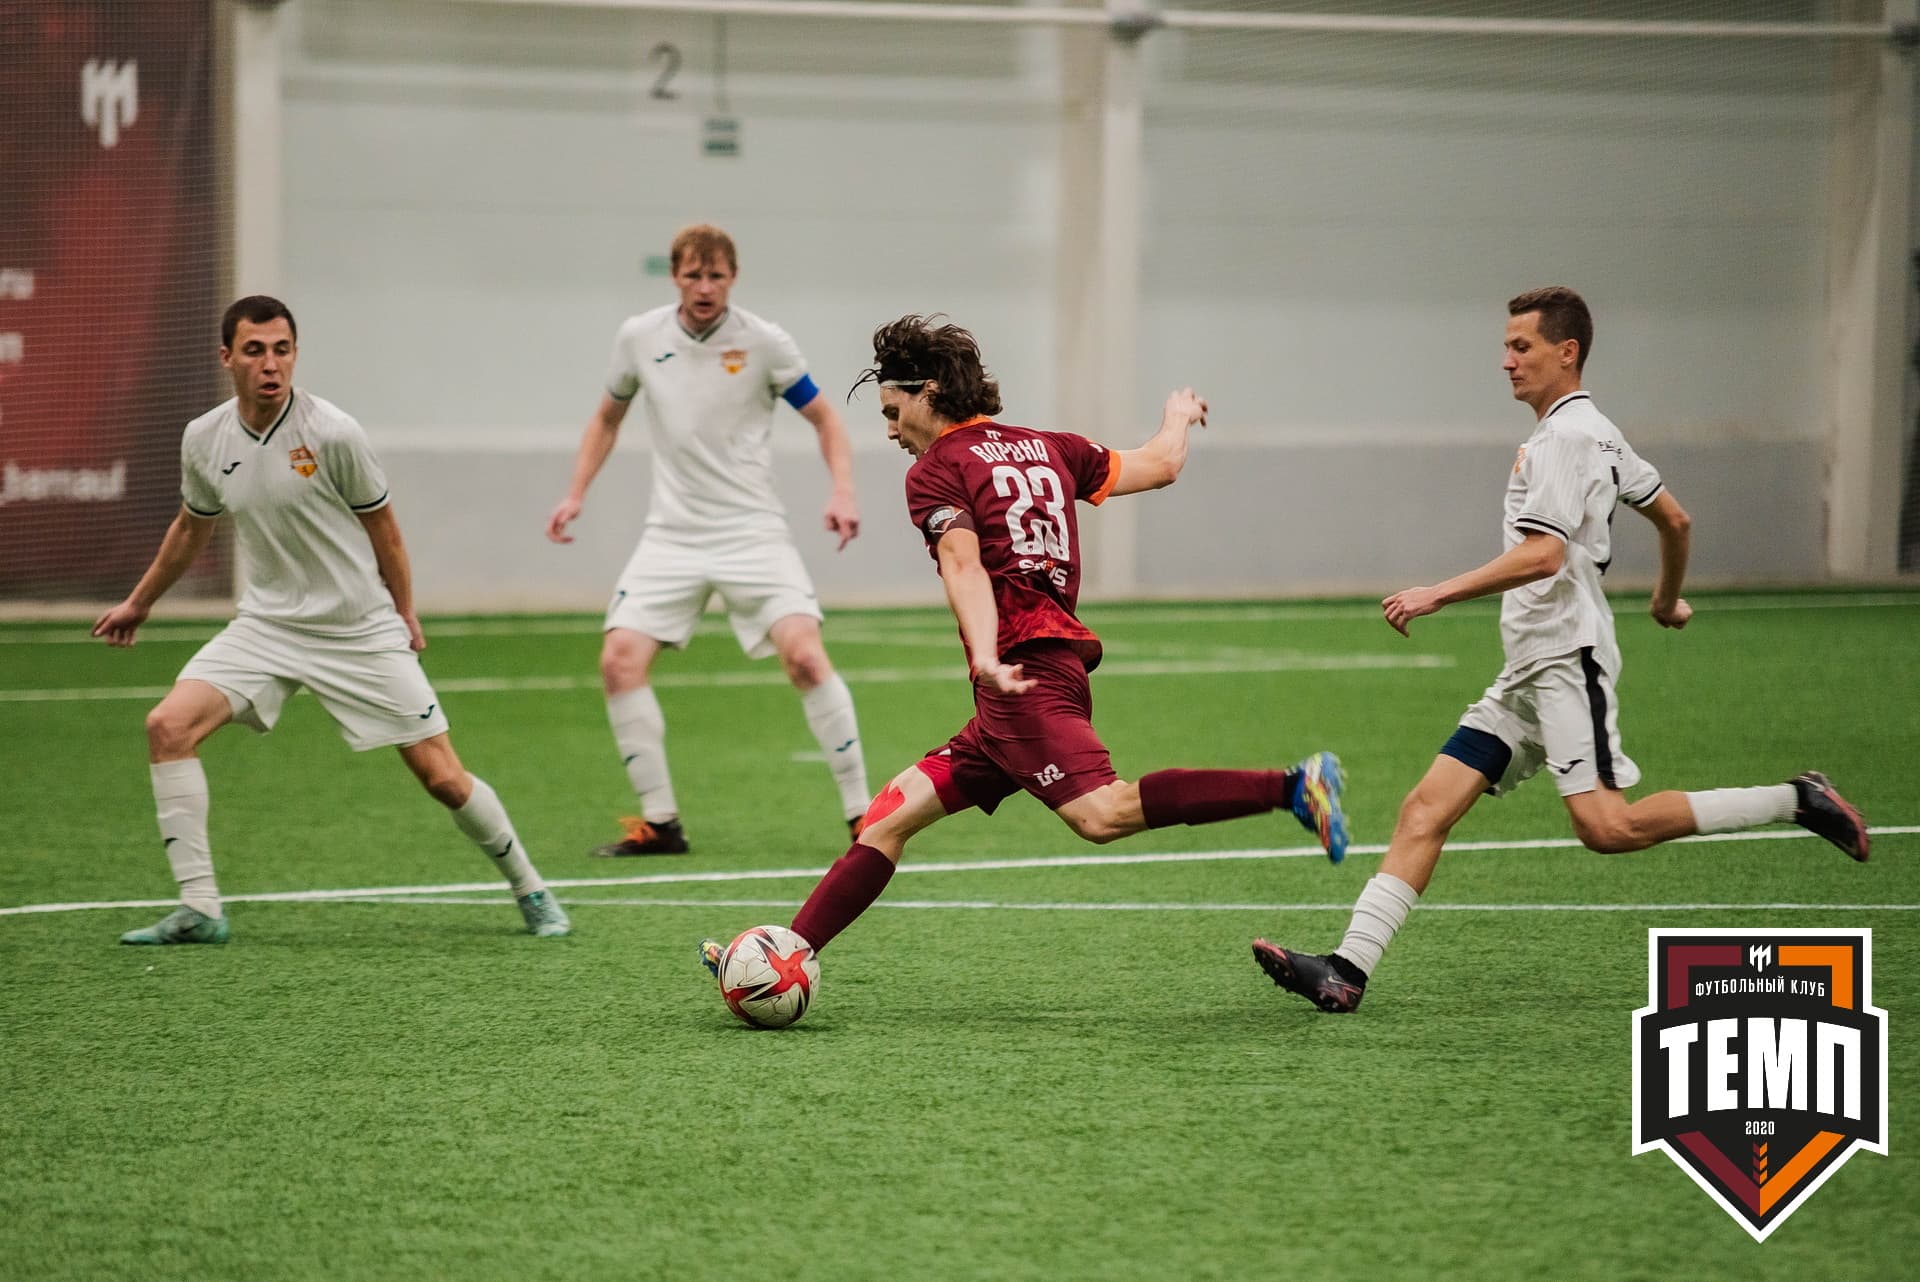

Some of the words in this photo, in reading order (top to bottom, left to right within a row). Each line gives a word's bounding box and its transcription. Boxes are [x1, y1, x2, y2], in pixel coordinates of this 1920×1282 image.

[648, 42, 682, 100] 2
[969, 439, 1050, 464] ВОРОНА
[992, 465, 1070, 562] 23
